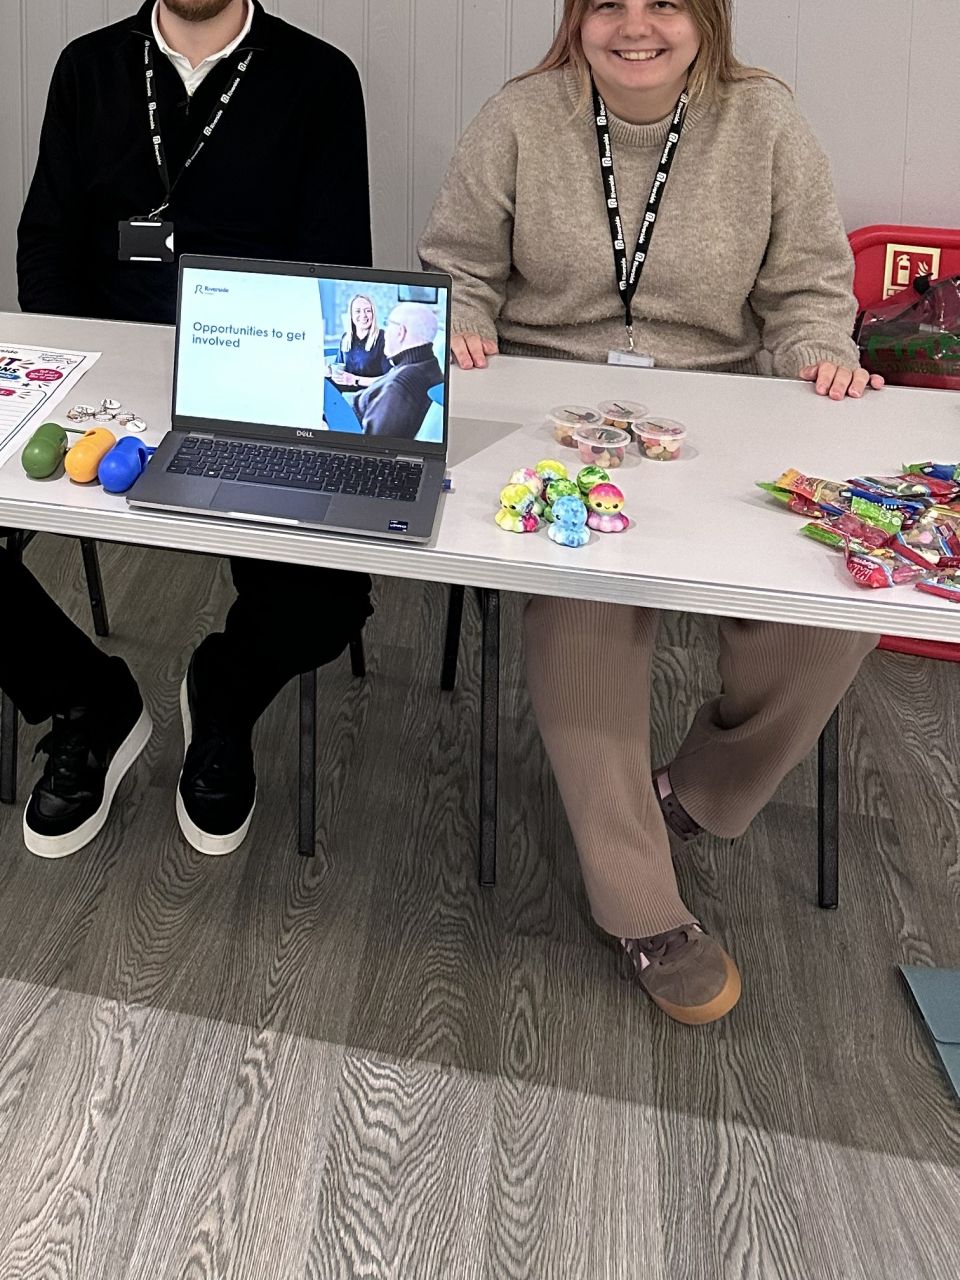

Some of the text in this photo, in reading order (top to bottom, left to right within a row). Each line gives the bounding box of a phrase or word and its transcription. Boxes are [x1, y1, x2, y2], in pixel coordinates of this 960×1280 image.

[193, 321, 306, 341] Opportunities to get
[192, 334, 240, 348] involved
[296, 430, 314, 438] DELL
